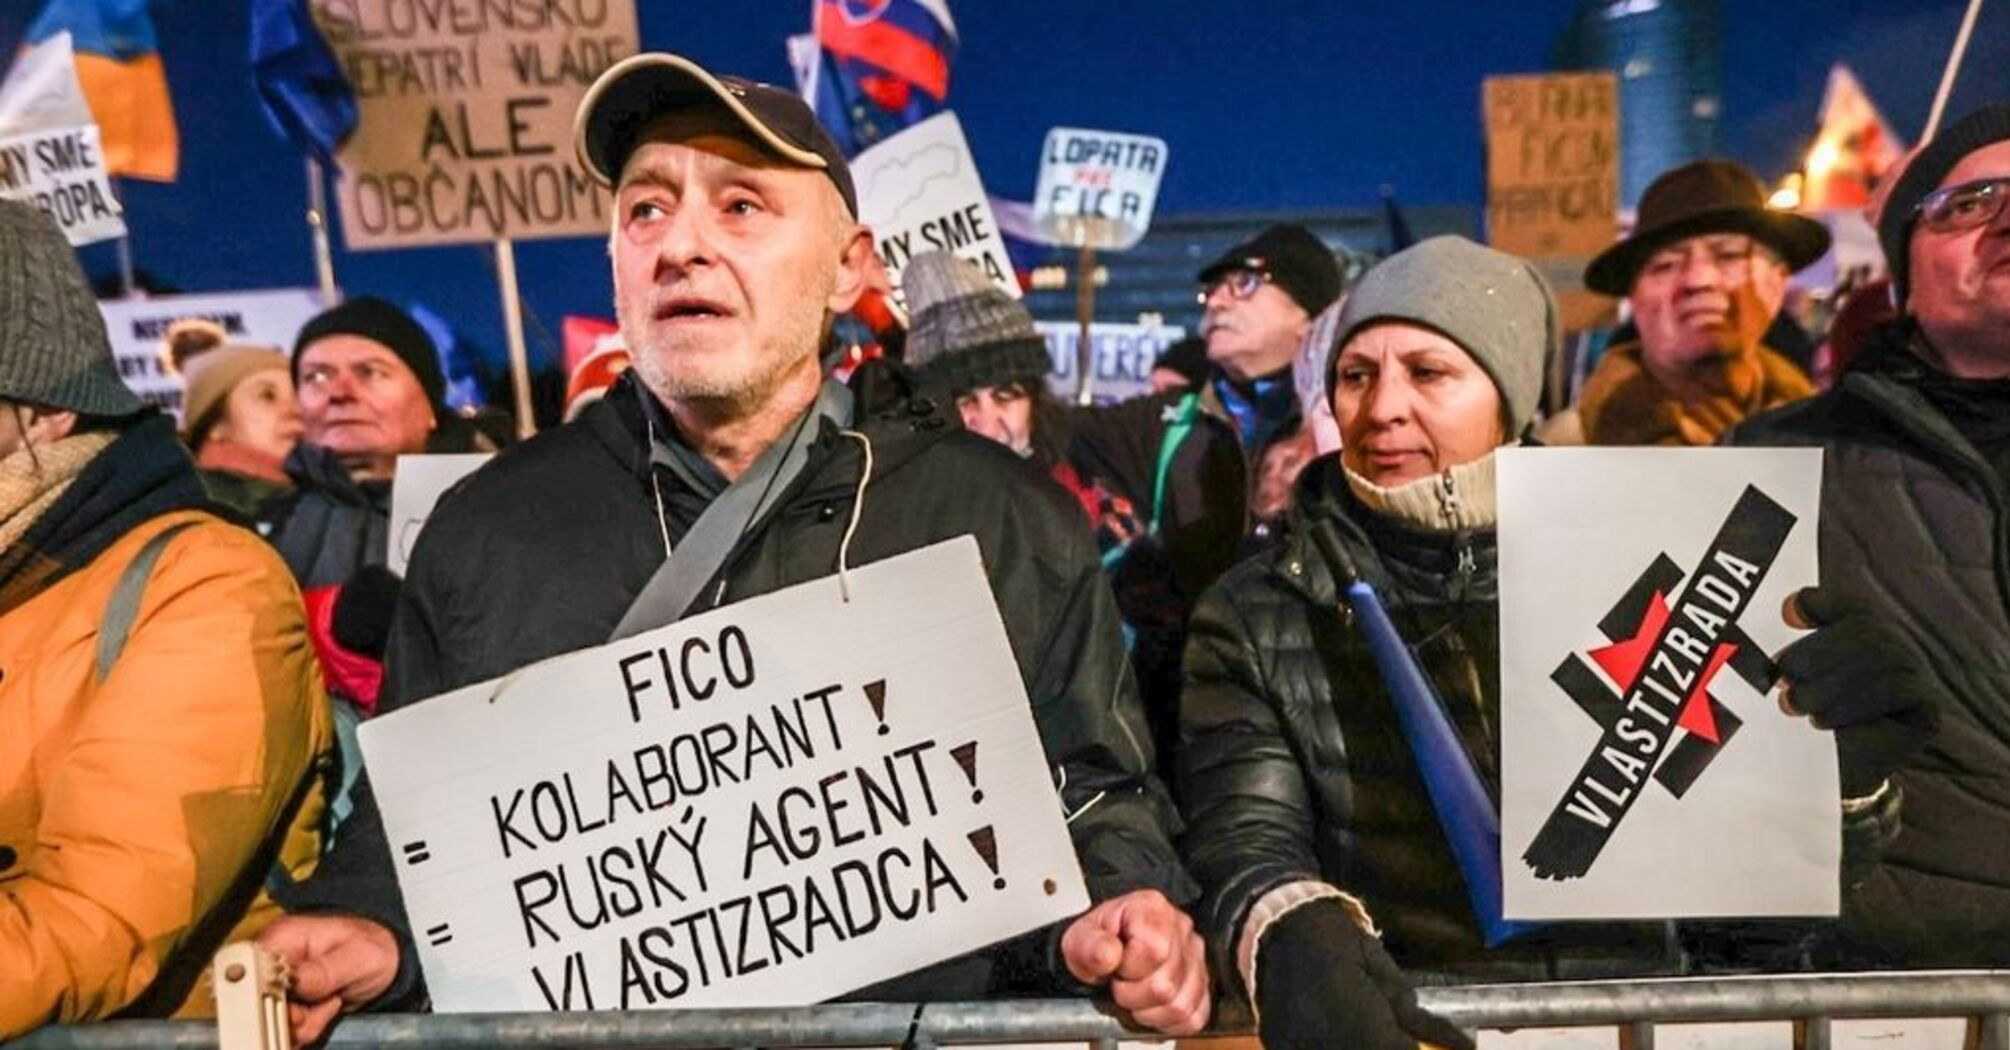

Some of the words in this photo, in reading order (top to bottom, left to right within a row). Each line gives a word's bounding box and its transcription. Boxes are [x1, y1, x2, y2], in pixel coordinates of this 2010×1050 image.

[418, 97, 554, 161] ALE
[920, 202, 990, 252] SME
[619, 626, 754, 722] FICO
[1566, 548, 1761, 829] VLASTIZRADA
[513, 805, 708, 948] RUSKÝ
